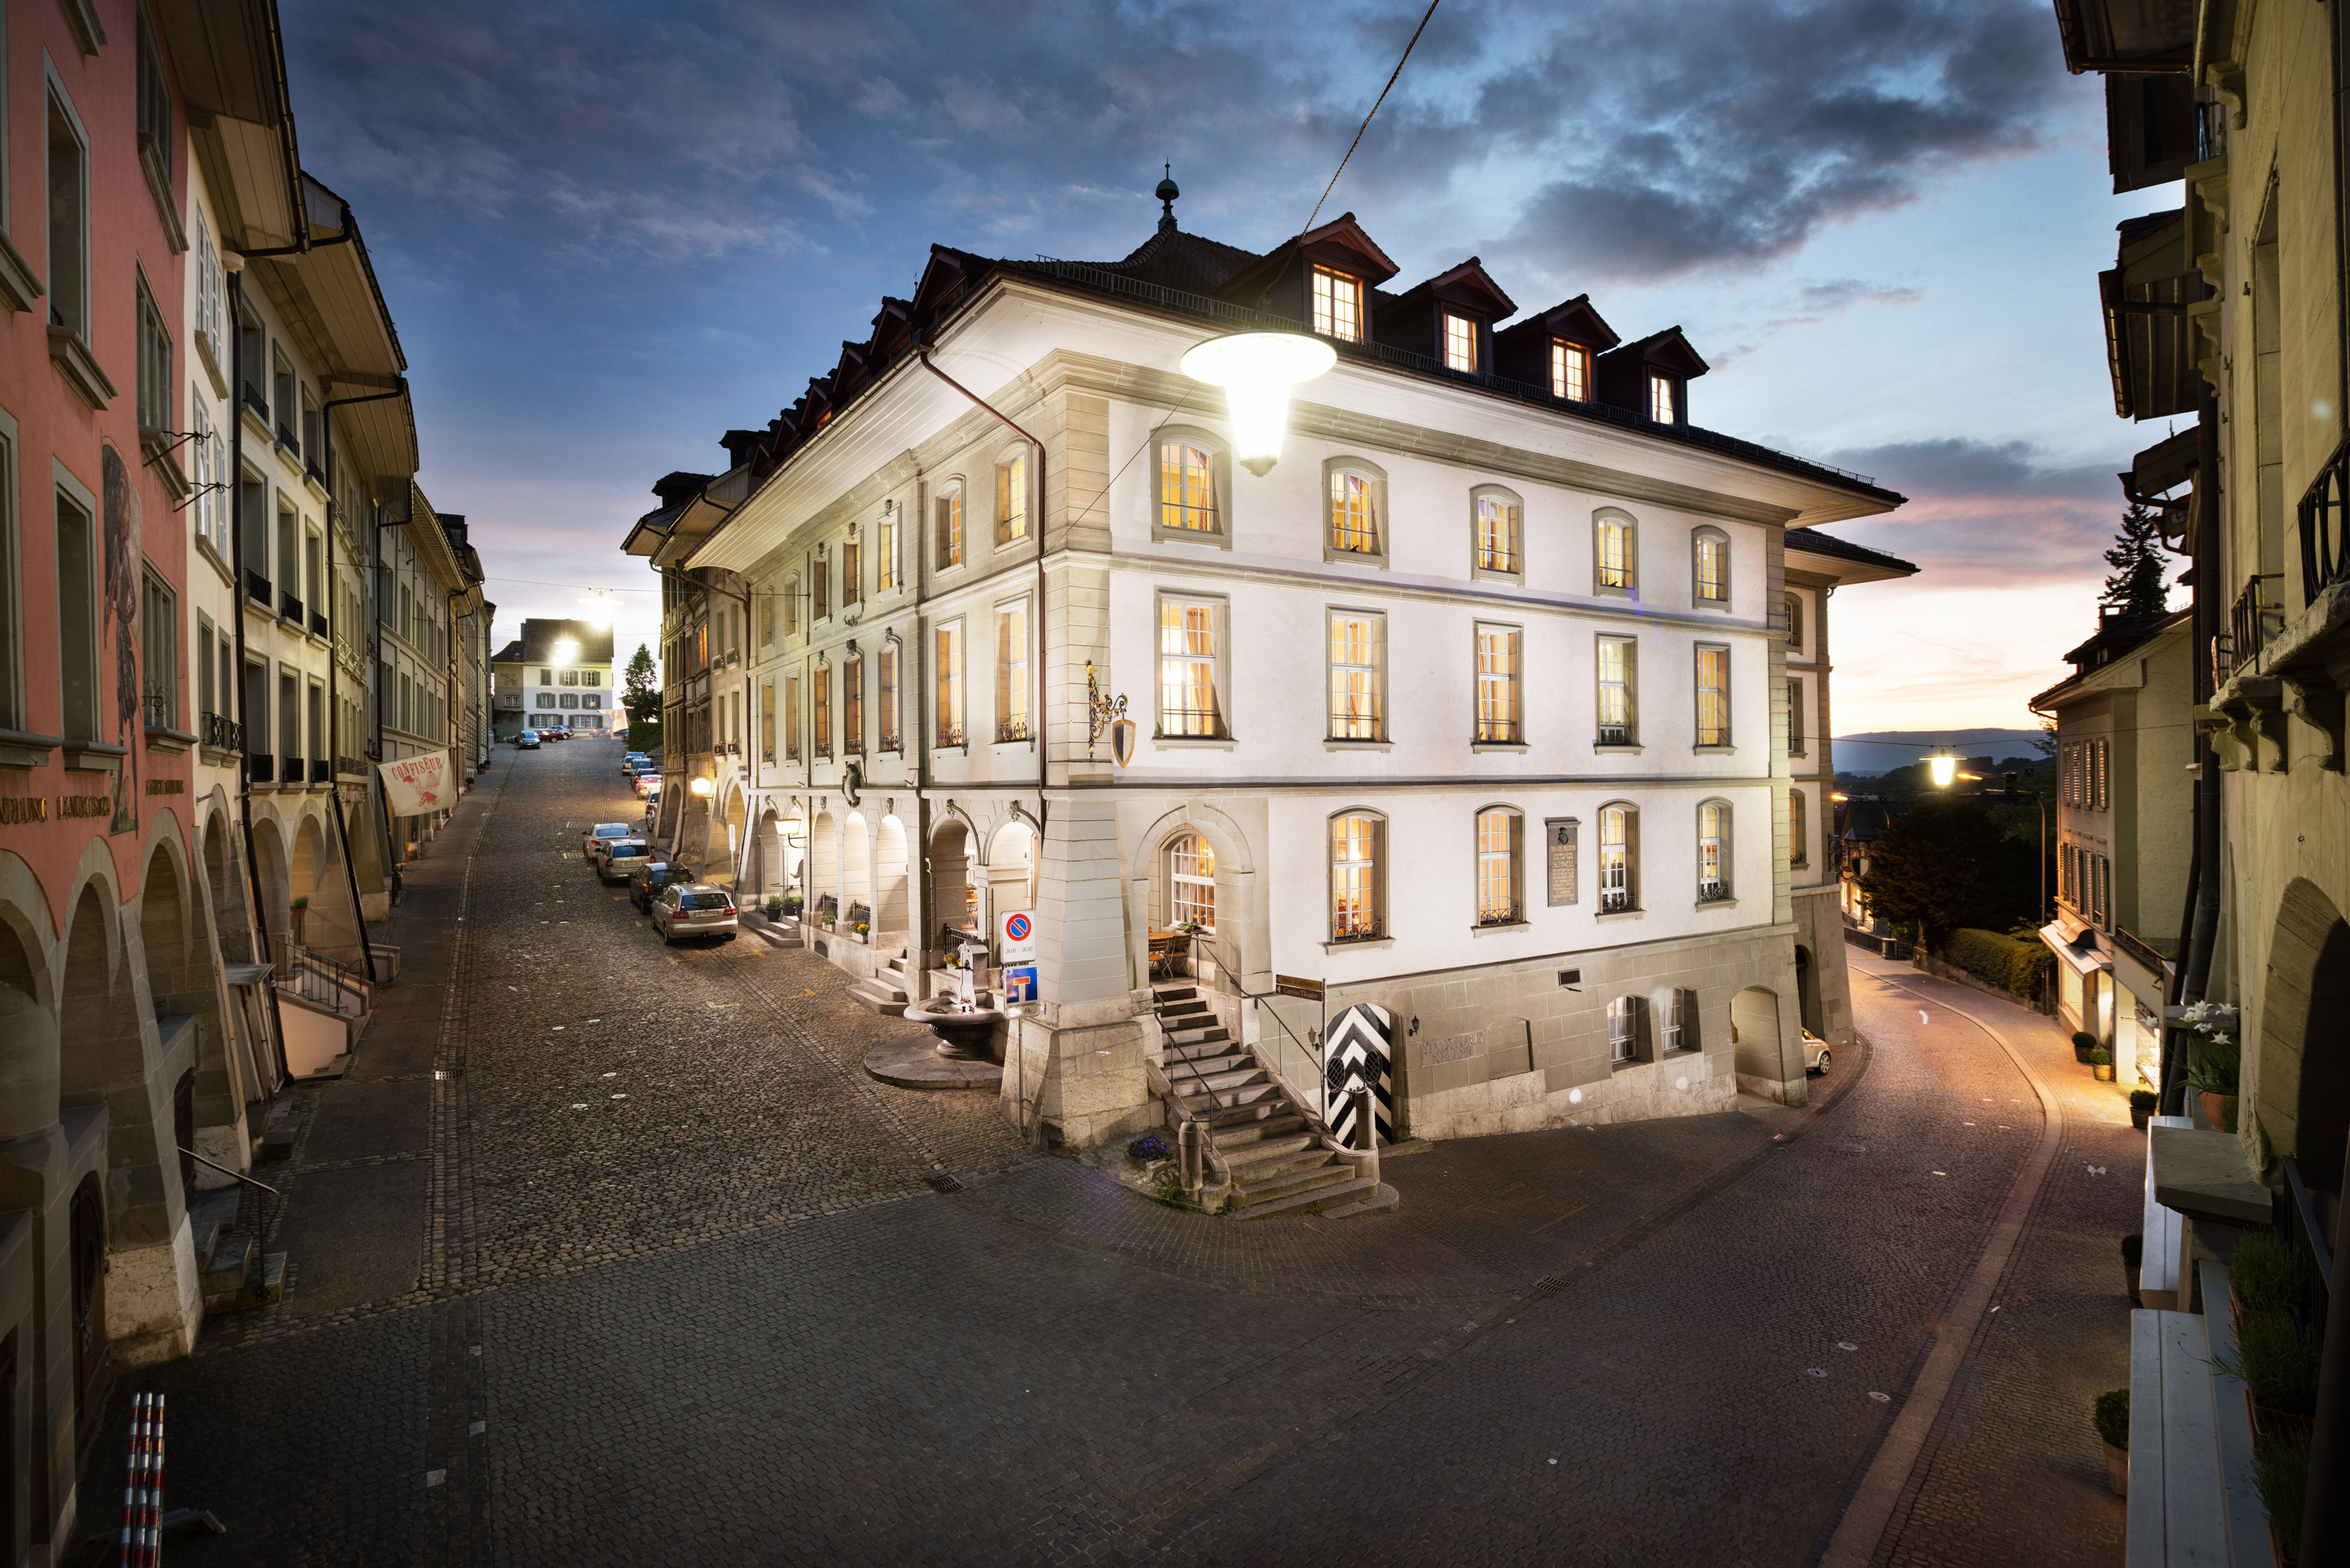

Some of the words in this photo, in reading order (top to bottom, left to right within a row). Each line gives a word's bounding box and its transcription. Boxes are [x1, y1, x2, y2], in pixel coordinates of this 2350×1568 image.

[391, 757, 443, 780] CONFISEUR
[1293, 978, 1314, 988] Stadthaus
[1423, 1032, 1483, 1054] STADTHAUS
[1432, 1046, 1473, 1064] KELLER
